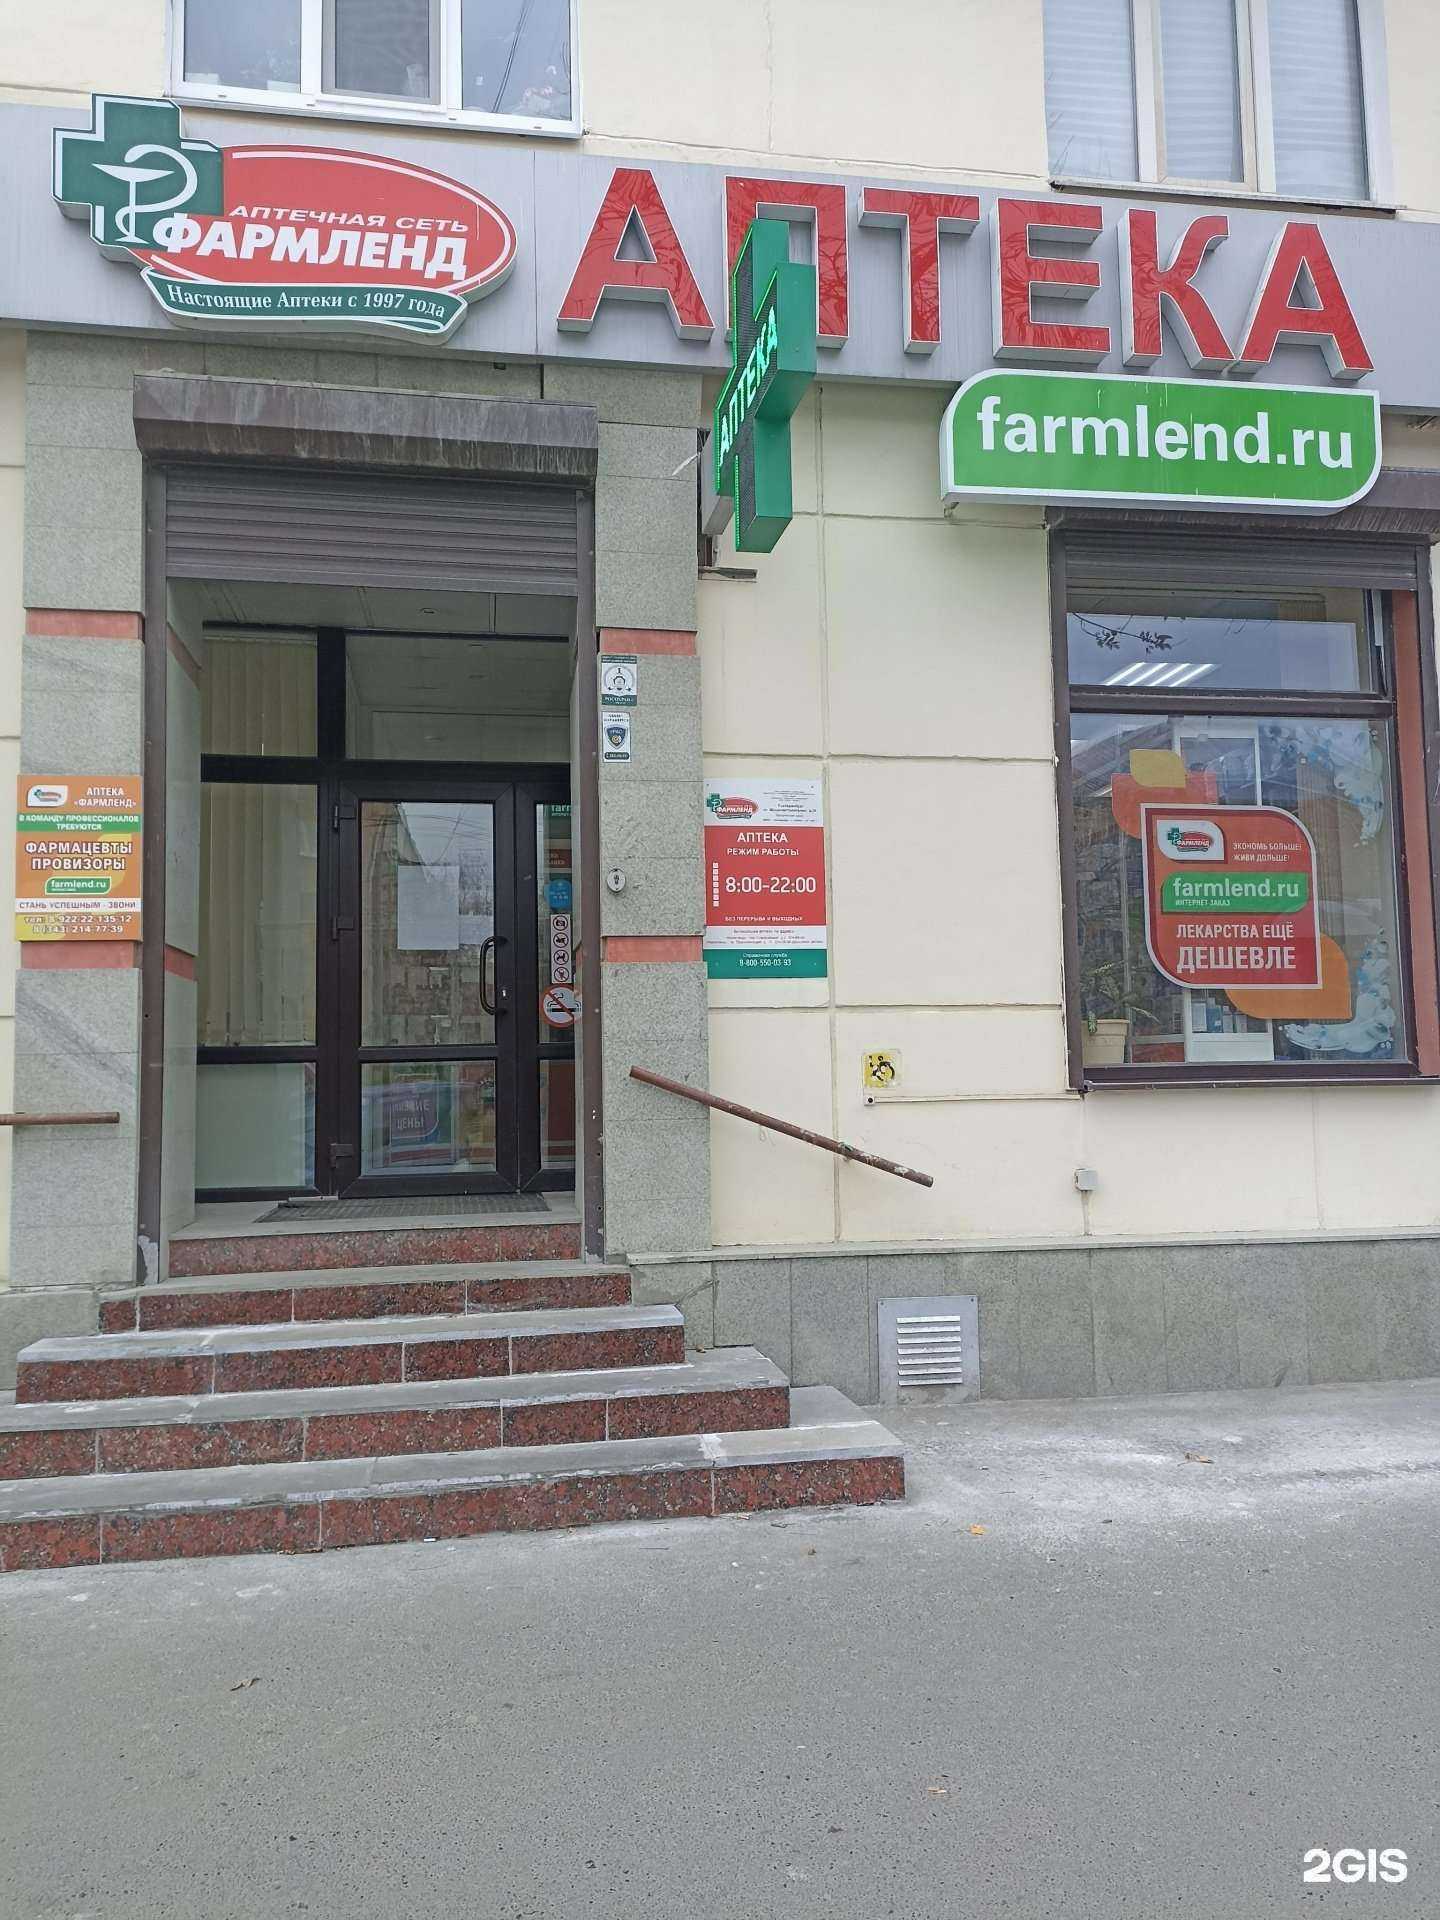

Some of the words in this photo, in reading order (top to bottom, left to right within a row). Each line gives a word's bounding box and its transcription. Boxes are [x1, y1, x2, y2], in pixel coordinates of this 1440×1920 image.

[229, 205, 388, 228] АПТЕЧНАЯ
[394, 218, 470, 232] СЕТЬ
[151, 212, 468, 281] ФАРМЛЕНД
[557, 167, 1375, 376] АПТЕКА
[166, 284, 273, 311] Настоящие
[277, 291, 343, 311] Аптеки
[347, 297, 358, 308] с
[363, 293, 405, 309] 1997
[408, 296, 446, 318] года
[719, 306, 778, 468] АПТЕКА
[976, 395, 1355, 470] farmlend.ru
[86, 787, 125, 796] АПТЕКА
[56, 823, 102, 831] ТРЕБУЮТСЯ
[736, 832, 789, 843] АПТЕКА
[25, 842, 132, 855] ФАРМАЦЕВТЫ
[727, 848, 760, 856] РЕЖИМ
[762, 848, 800, 856] РАБОТЫ
[1232, 842, 1268, 851] ЭКОНОМЬ
[1269, 843, 1302, 852] БОЛЬШЕ!
[32, 858, 126, 870] ПРОВИЗОРЫ
[1232, 854, 1255, 863] ЖИВИ
[1256, 854, 1290, 863] ДОЛЬШЕ!
[51, 880, 107, 888] farmlend.ru
[725, 876, 817, 893] 8:00-22:00
[1172, 877, 1300, 898] farmlend.ru
[49, 901, 101, 909] УСПЕШНЫМ
[1176, 924, 1260, 940] ЛЕКАРСТВА
[1263, 921, 1295, 940] ЕЩЁ
[1176, 946, 1297, 974] ДЕШЕВЛЕ
